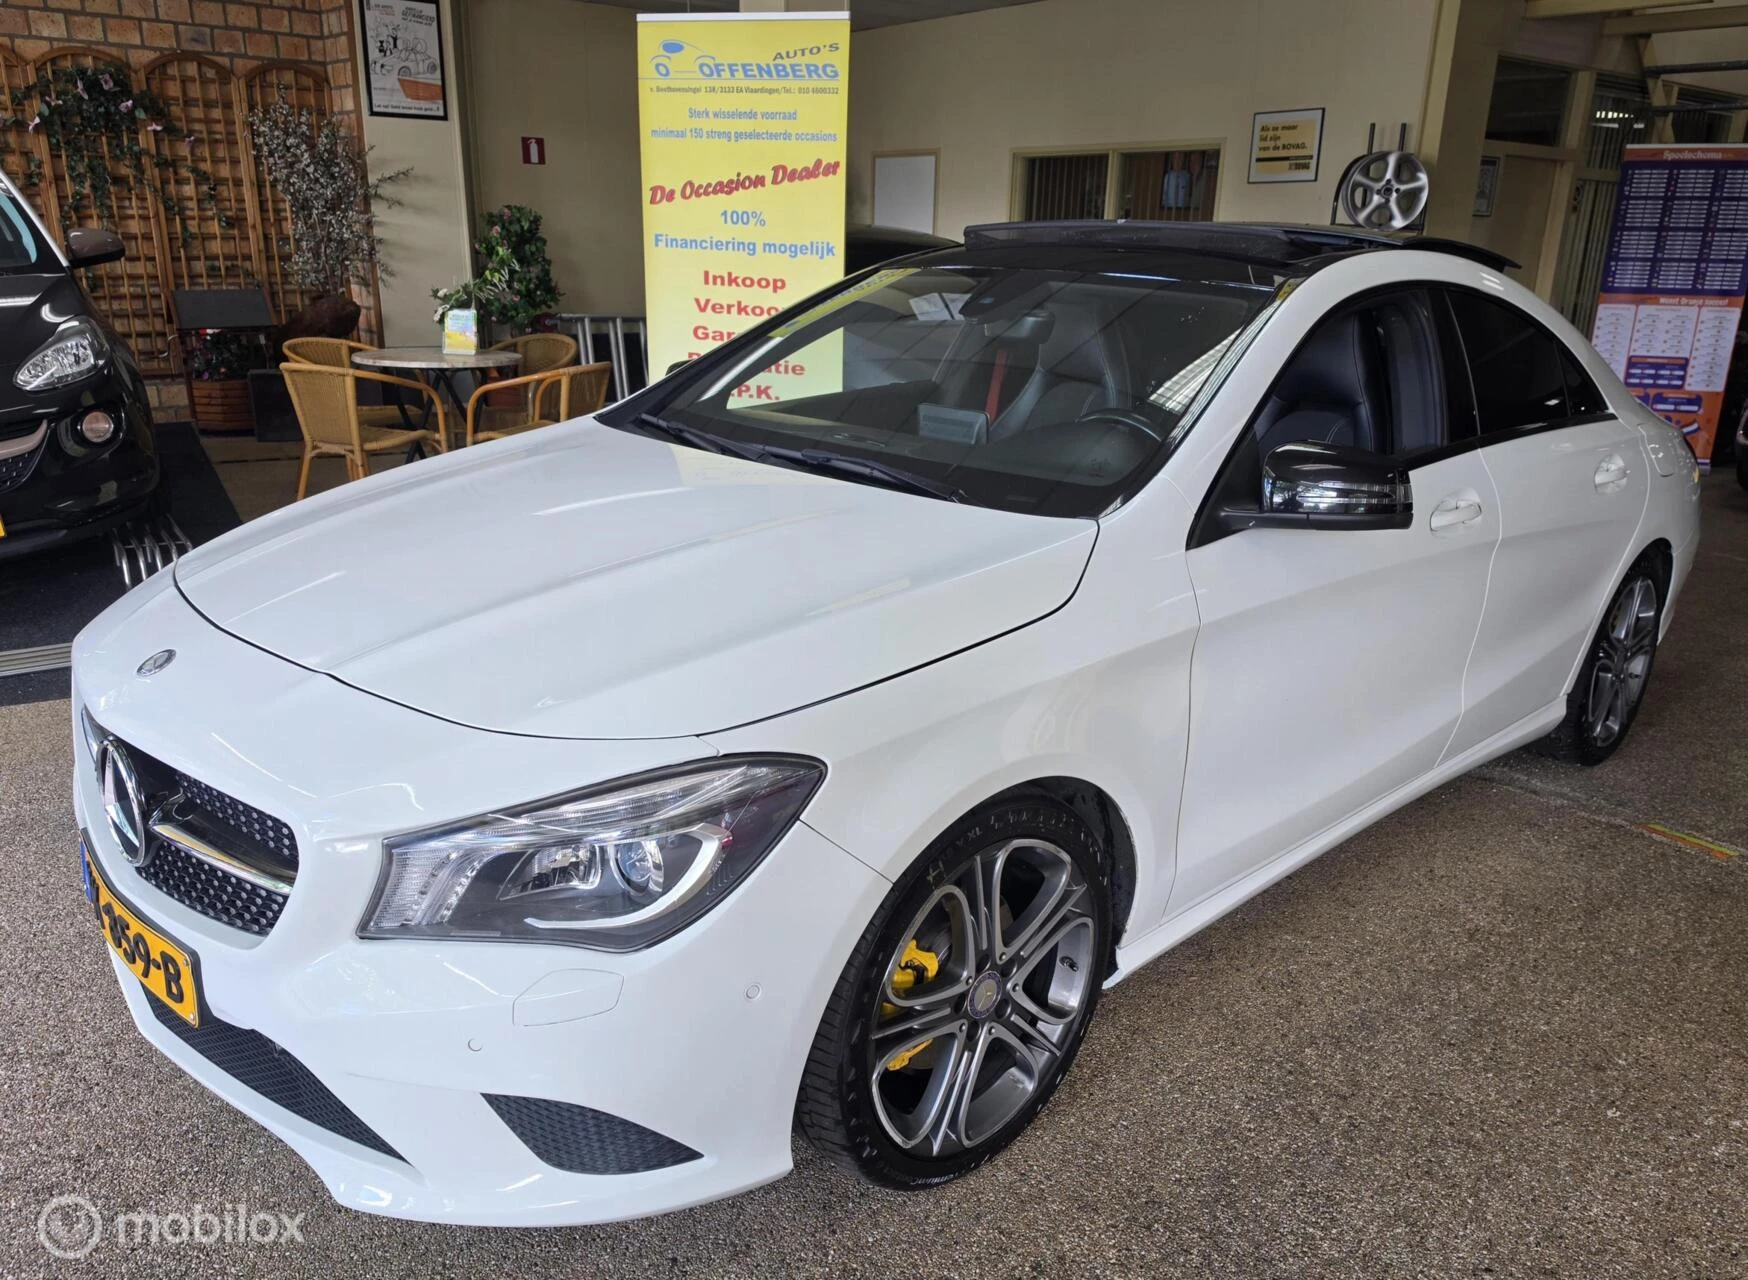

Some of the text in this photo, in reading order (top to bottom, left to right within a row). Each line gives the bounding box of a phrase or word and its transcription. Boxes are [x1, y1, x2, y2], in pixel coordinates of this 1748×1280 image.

[772, 42, 840, 62] AUTO'S
[699, 62, 839, 79] OFFENBERG
[688, 107, 797, 121] Sterk wisselende voorraad
[651, 128, 838, 143] minimaal 150 streng geselecteerde occasions
[649, 158, 841, 205] De Occasion Dealer
[720, 210, 766, 227] 100%
[654, 233, 836, 260] Financiering mogelijk
[703, 270, 787, 293] Inkoop
[694, 297, 783, 317] Verkoo
[731, 383, 780, 401] .P.K.
